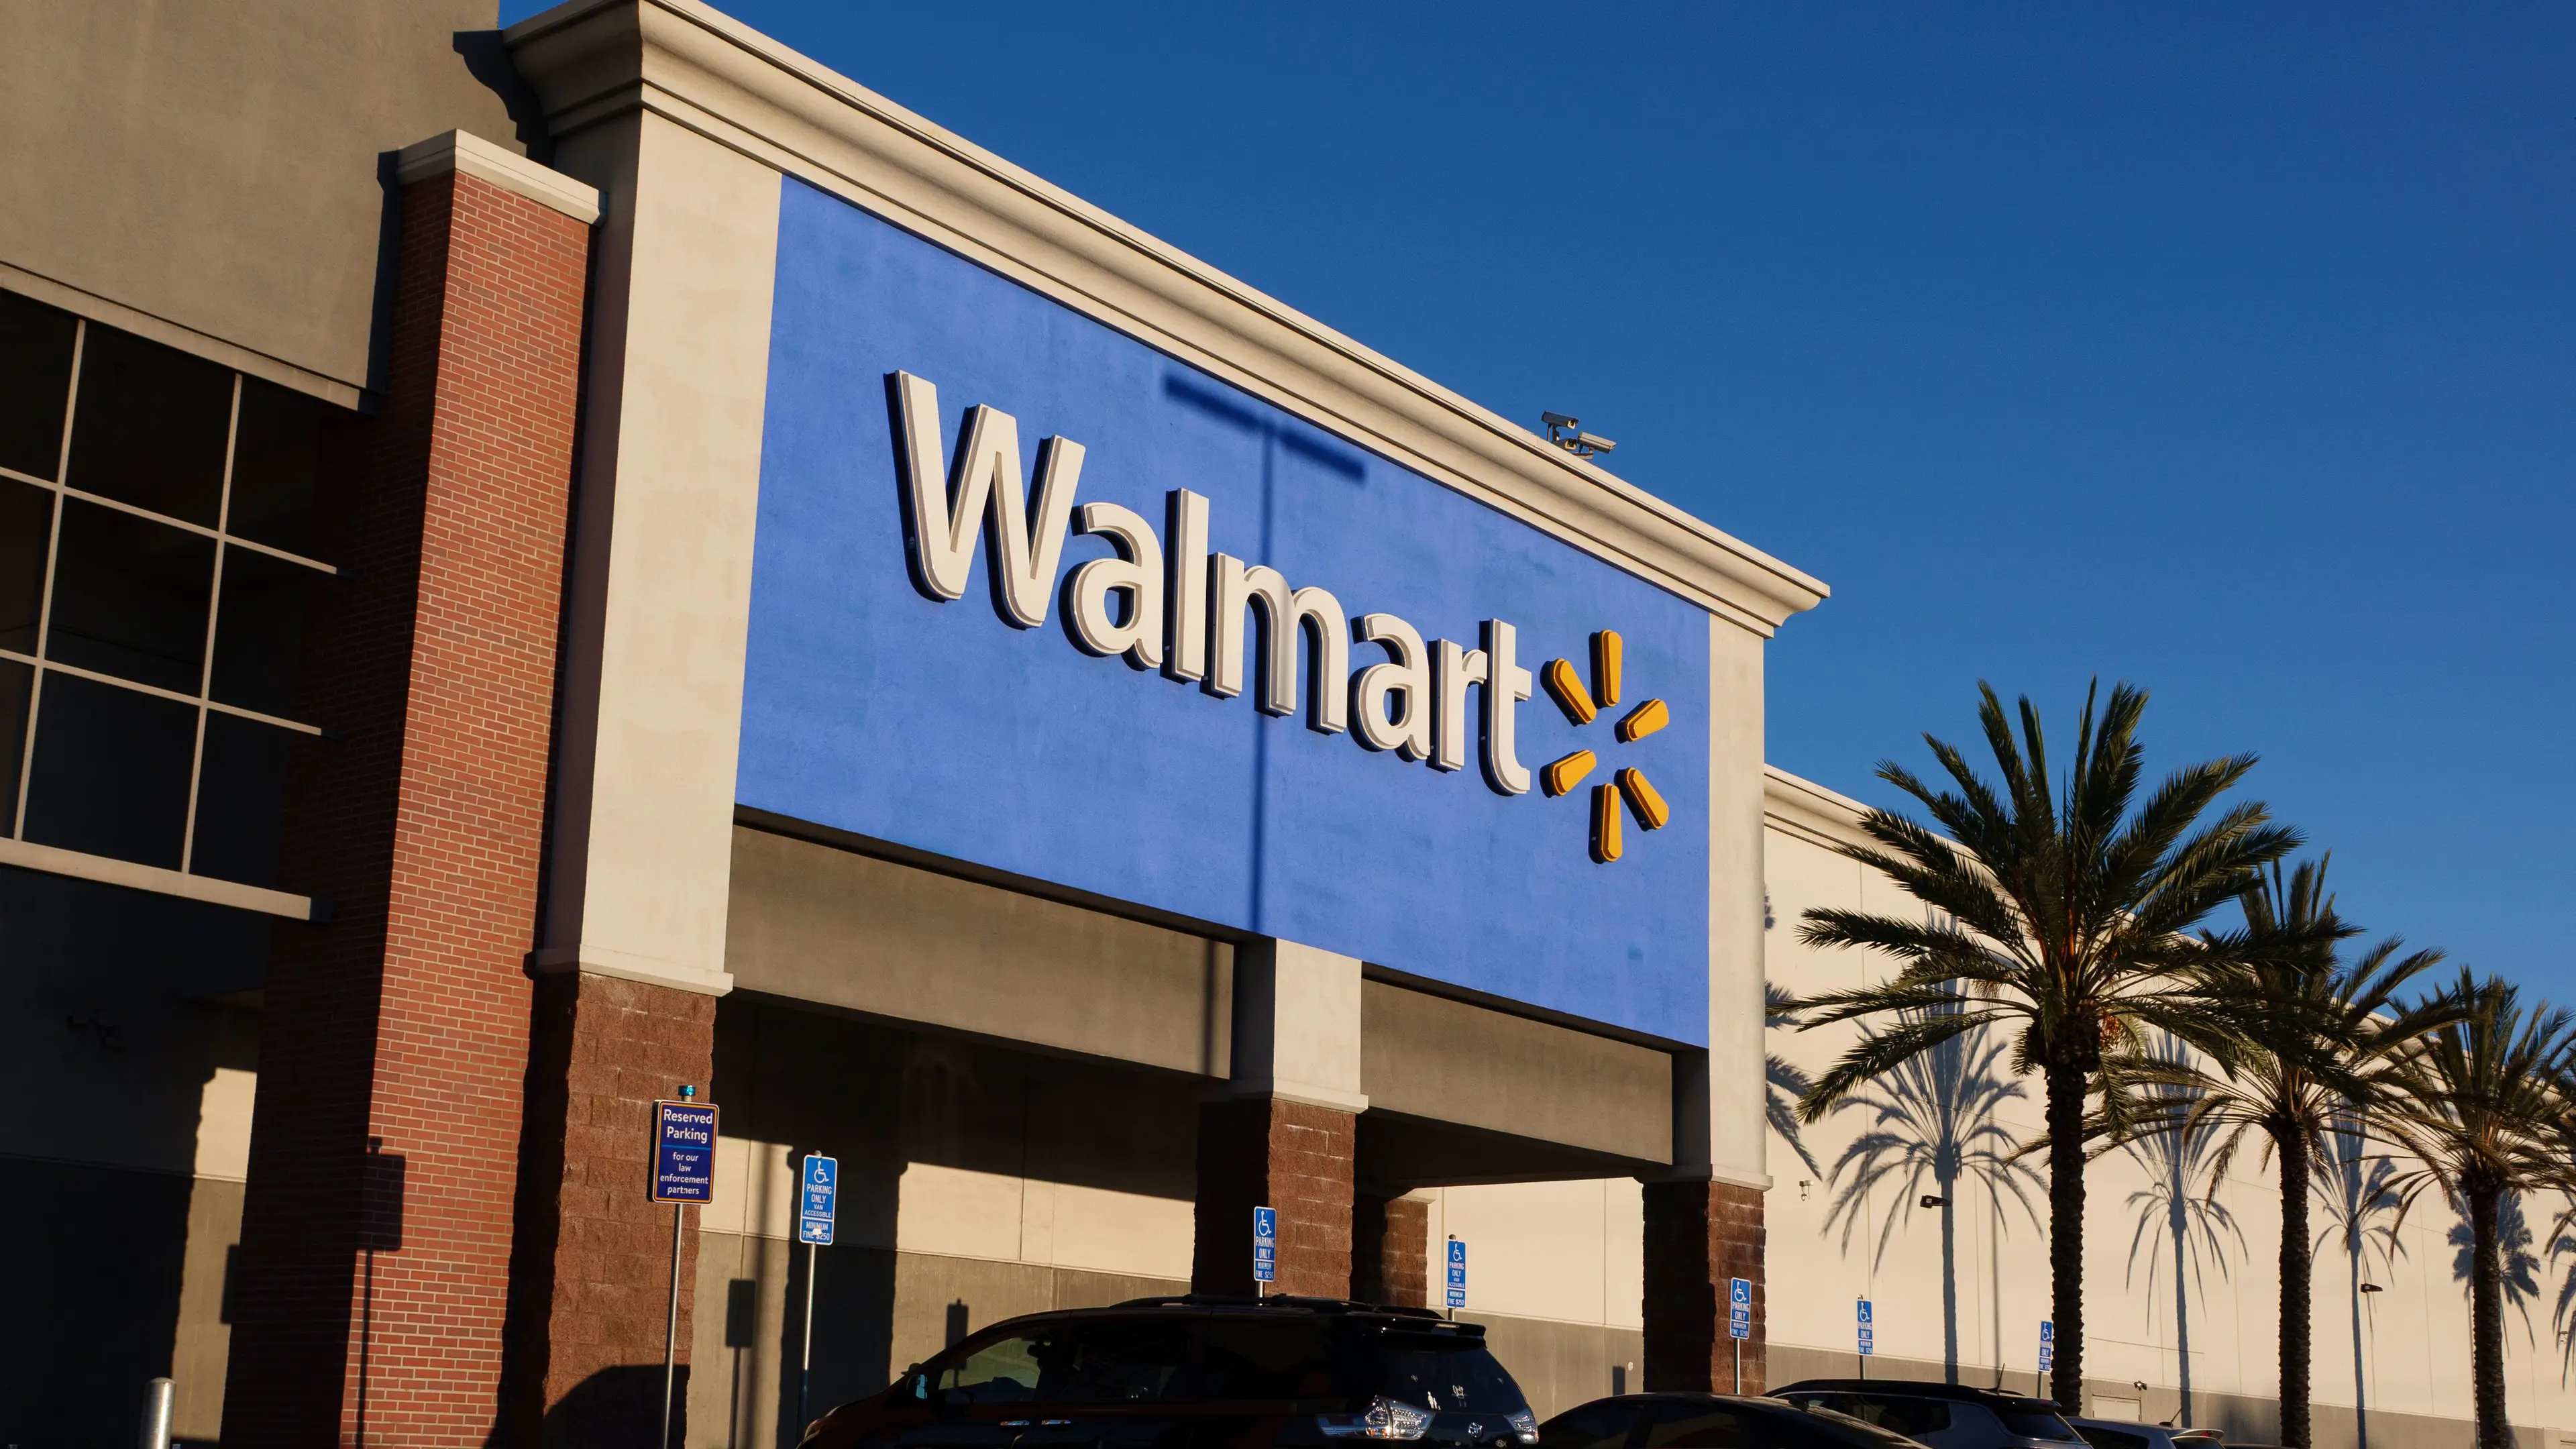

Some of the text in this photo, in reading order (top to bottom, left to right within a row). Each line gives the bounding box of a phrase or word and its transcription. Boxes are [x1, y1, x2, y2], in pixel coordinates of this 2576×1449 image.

[885, 369, 1533, 796] Walmart
[663, 1109, 713, 1124] Reserved
[667, 1126, 708, 1144] Parking
[673, 1151, 699, 1162] for our
[678, 1163, 691, 1172] law
[660, 1174, 708, 1185] enforcement
[667, 1186, 700, 1195] partners
[806, 1183, 832, 1195] PARKING
[811, 1194, 826, 1204] ONLY
[804, 1210, 832, 1218] ACCESSIBLE
[806, 1221, 828, 1231] MINIMUM
[802, 1230, 814, 1239] FINE
[1256, 1236, 1275, 1248] PARKING
[1258, 1248, 1271, 1259] ONLY
[1449, 1261, 1464, 1270] PARKING
[1452, 1269, 1462, 1277] ONLY
[1732, 1301, 1750, 1312] PARKING
[1735, 1311, 1746, 1320] ONLY
